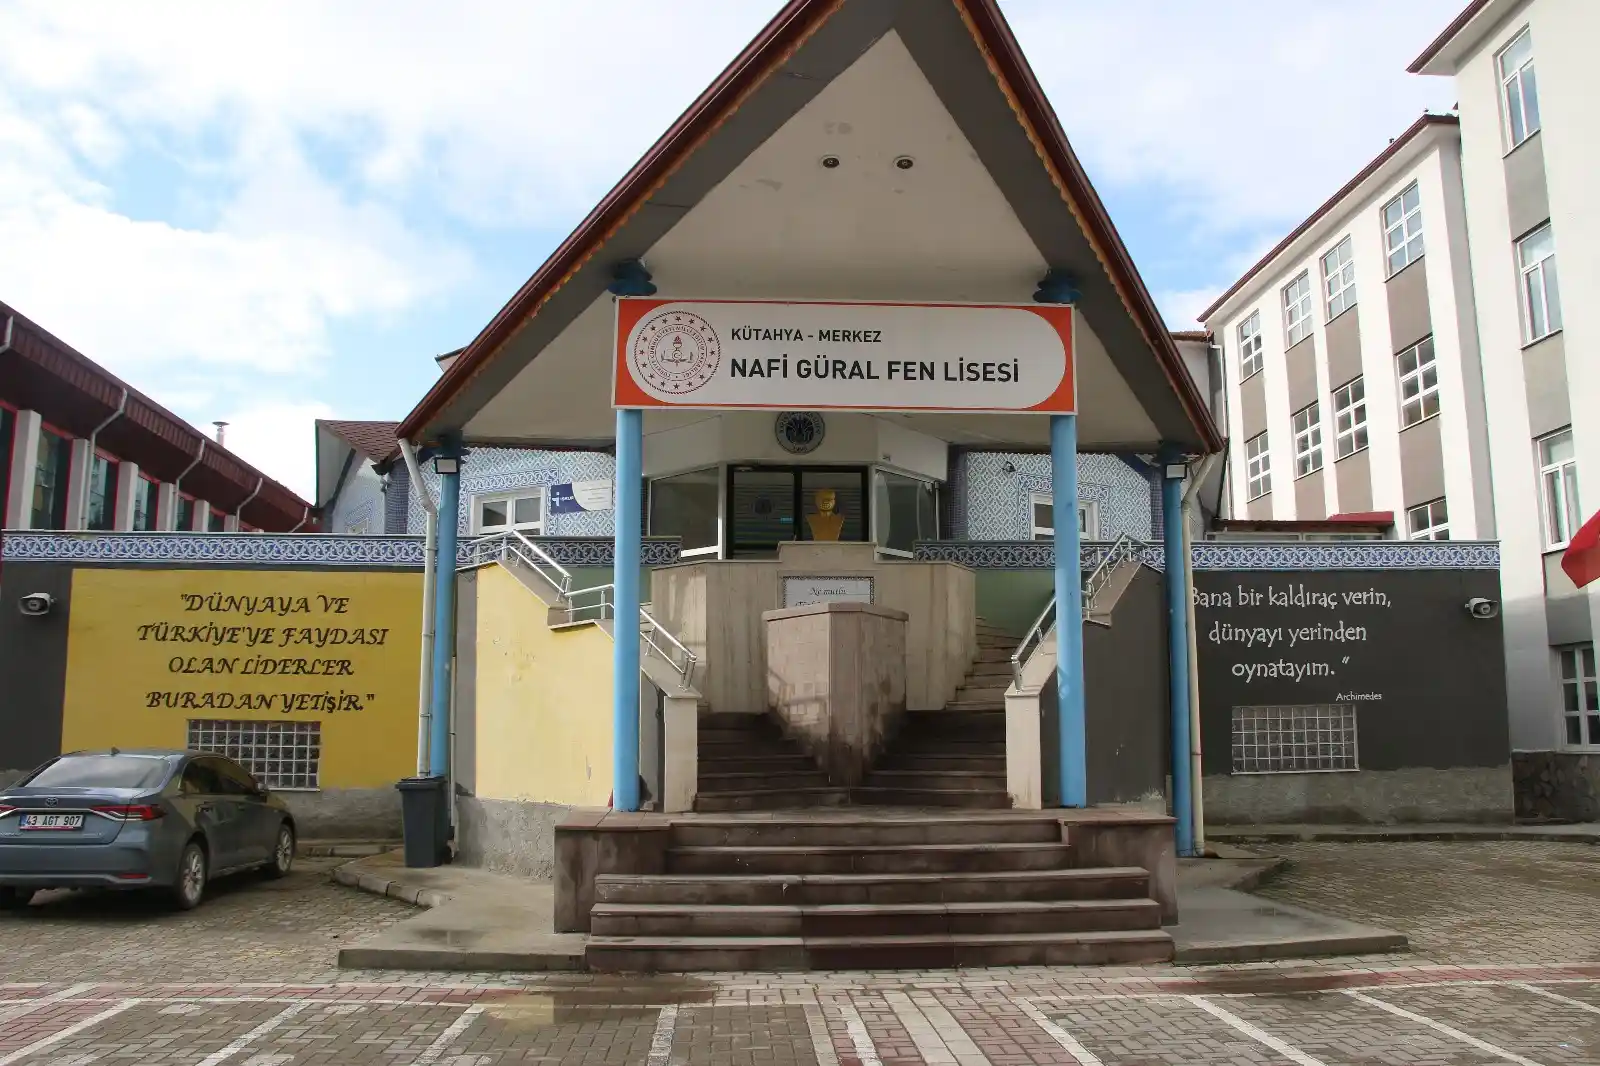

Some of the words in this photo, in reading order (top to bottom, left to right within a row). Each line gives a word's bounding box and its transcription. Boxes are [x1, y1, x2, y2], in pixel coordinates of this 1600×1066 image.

[731, 326, 804, 342] KÜTAHYA
[818, 329, 882, 343] MERKEZ
[730, 354, 788, 379] NAFİ
[796, 355, 880, 380] GÜRAL
[887, 361, 935, 381] FEN
[943, 357, 1019, 383] LİSESİ
[181, 592, 311, 616] "DÜNYAYA
[317, 595, 350, 614] VE
[1192, 586, 1232, 608] Bana
[1238, 585, 1264, 606] bir
[1268, 584, 1338, 609] kaldıraç
[1342, 587, 1392, 608] verin,
[138, 623, 275, 648] TÜRKİYE'YE
[279, 627, 389, 648] FAYDASI
[1208, 620, 1283, 648] dünyayı
[1288, 620, 1367, 648] yerinden
[168, 656, 239, 675] OLAN
[240, 654, 355, 676] LİDERLER
[145, 691, 278, 711] BURADAN
[279, 689, 375, 714] YETİŞİR."
[1335, 690, 1383, 702] Archimedes
[26, 815, 38, 826] 43
[42, 815, 60, 826] AGT
[63, 815, 81, 826] 907
